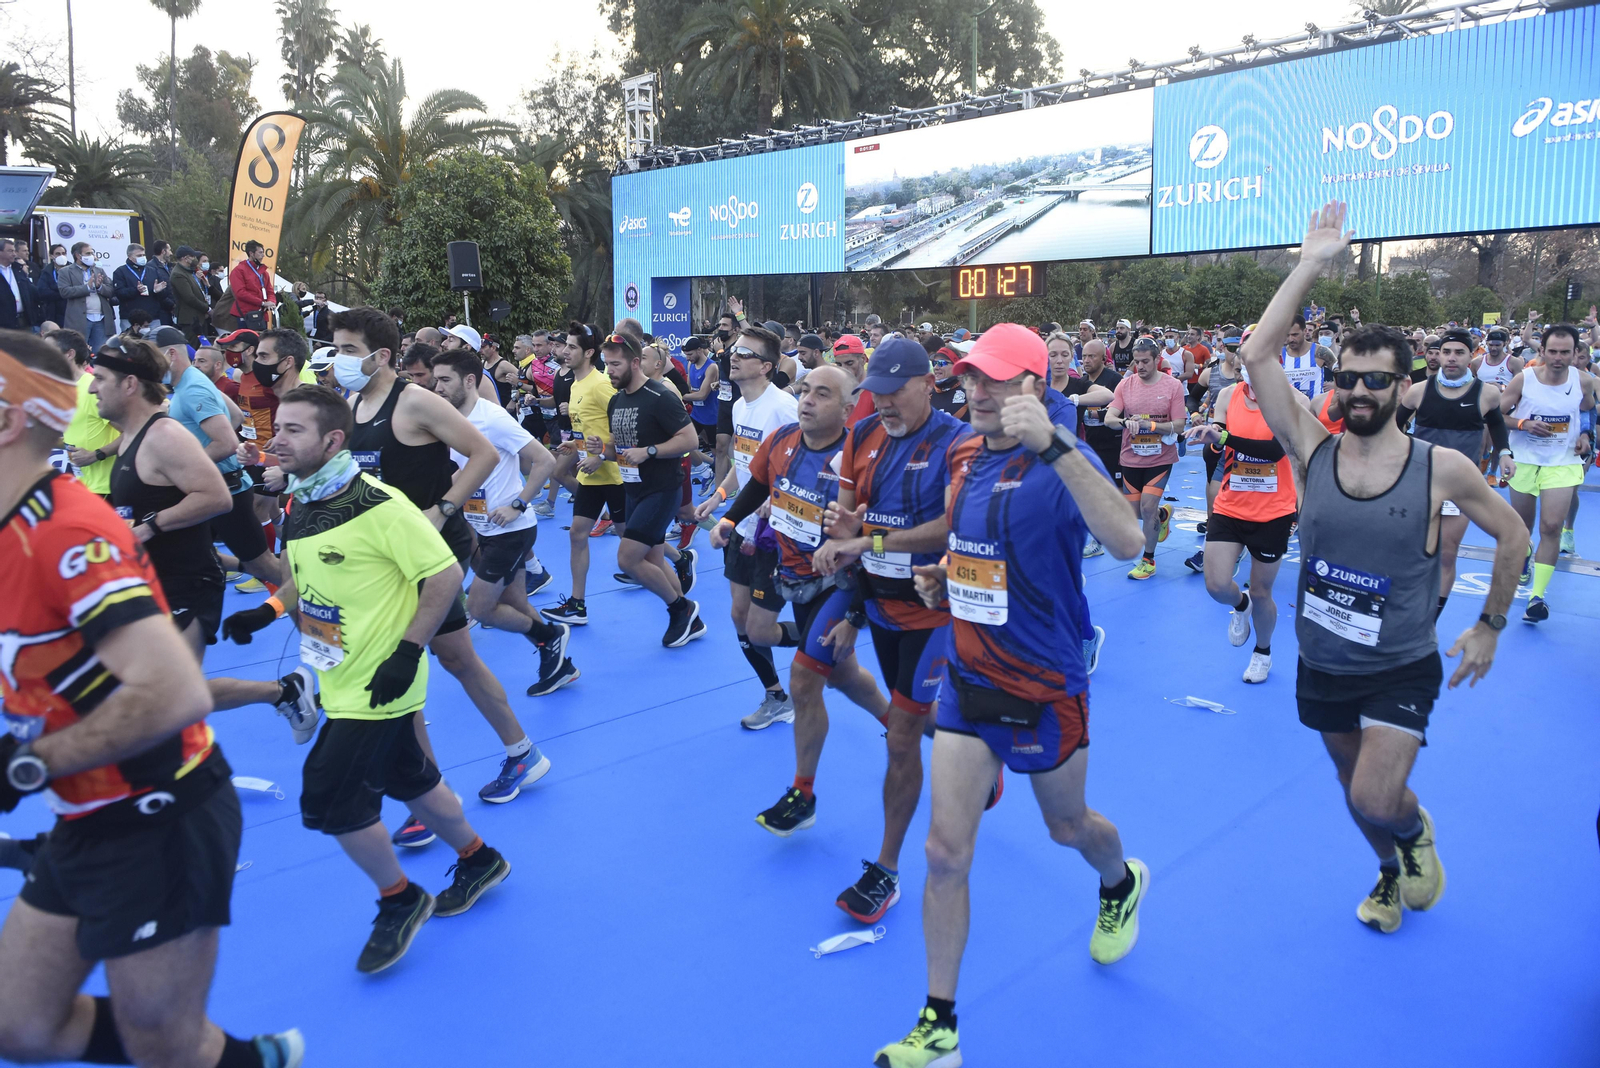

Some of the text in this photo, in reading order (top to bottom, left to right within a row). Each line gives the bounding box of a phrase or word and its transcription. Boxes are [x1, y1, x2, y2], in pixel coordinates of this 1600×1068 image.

[1549, 98, 1600, 128] asi
[1156, 175, 1263, 209] ZURICH
[243, 192, 274, 212] IMD
[780, 221, 837, 240] ZURICH
[652, 313, 688, 322] ZURICH
[741, 428, 760, 439] ZURICH
[351, 454, 376, 463] ZURICH
[1244, 467, 1261, 475] 3332
[789, 484, 823, 502] ZURICH
[787, 501, 804, 516] 5514
[785, 513, 804, 529] BRUNO
[867, 513, 905, 526] ZURICH
[956, 539, 994, 556] ZURICH
[956, 565, 978, 582] 4315
[1330, 568, 1380, 590] ZURICH
[962, 588, 995, 604] MARTÍN
[1326, 588, 1356, 607] 2427
[303, 604, 333, 620] ZURICH
[1325, 605, 1353, 623] JORGE
